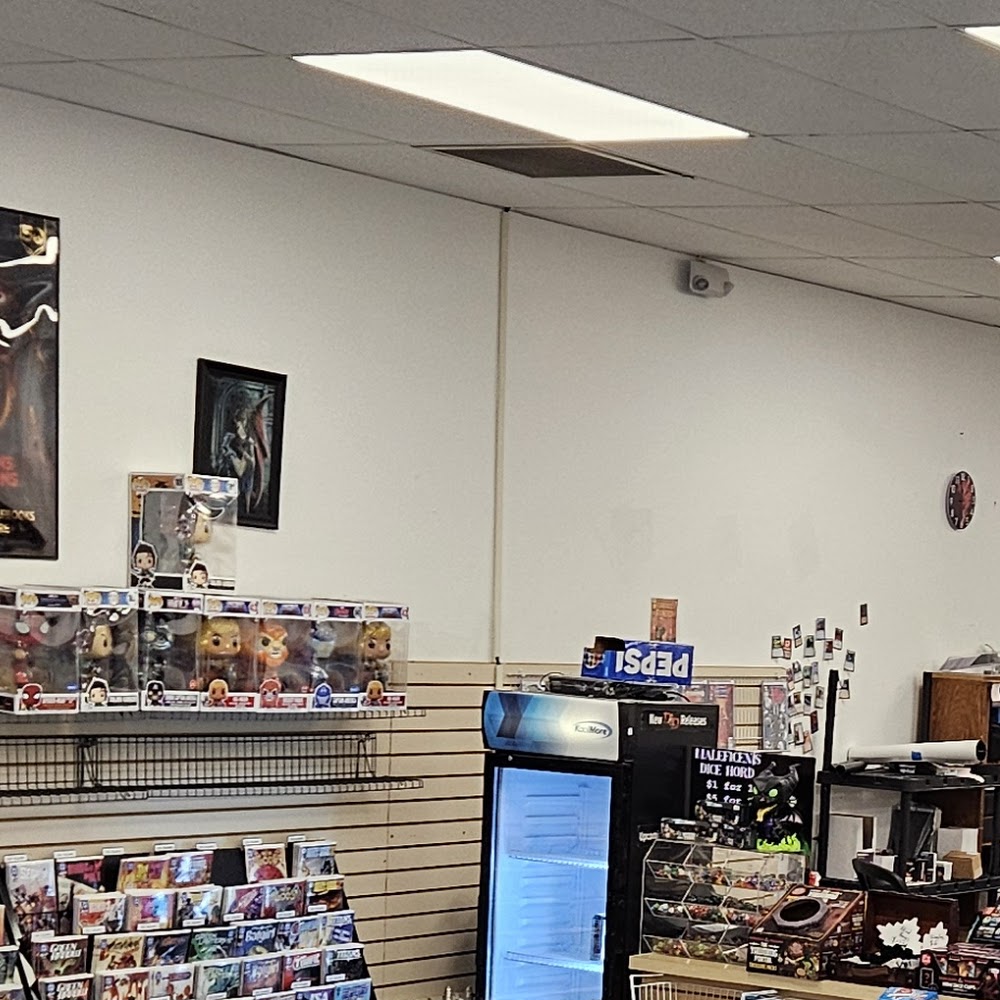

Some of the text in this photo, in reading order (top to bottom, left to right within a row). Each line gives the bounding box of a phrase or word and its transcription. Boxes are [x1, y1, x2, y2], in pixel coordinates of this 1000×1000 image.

[615, 648, 690, 678] PEPSI
[699, 762, 755, 779] DICE HORD
[706, 779, 718, 789] $1
[723, 781, 742, 792] for
